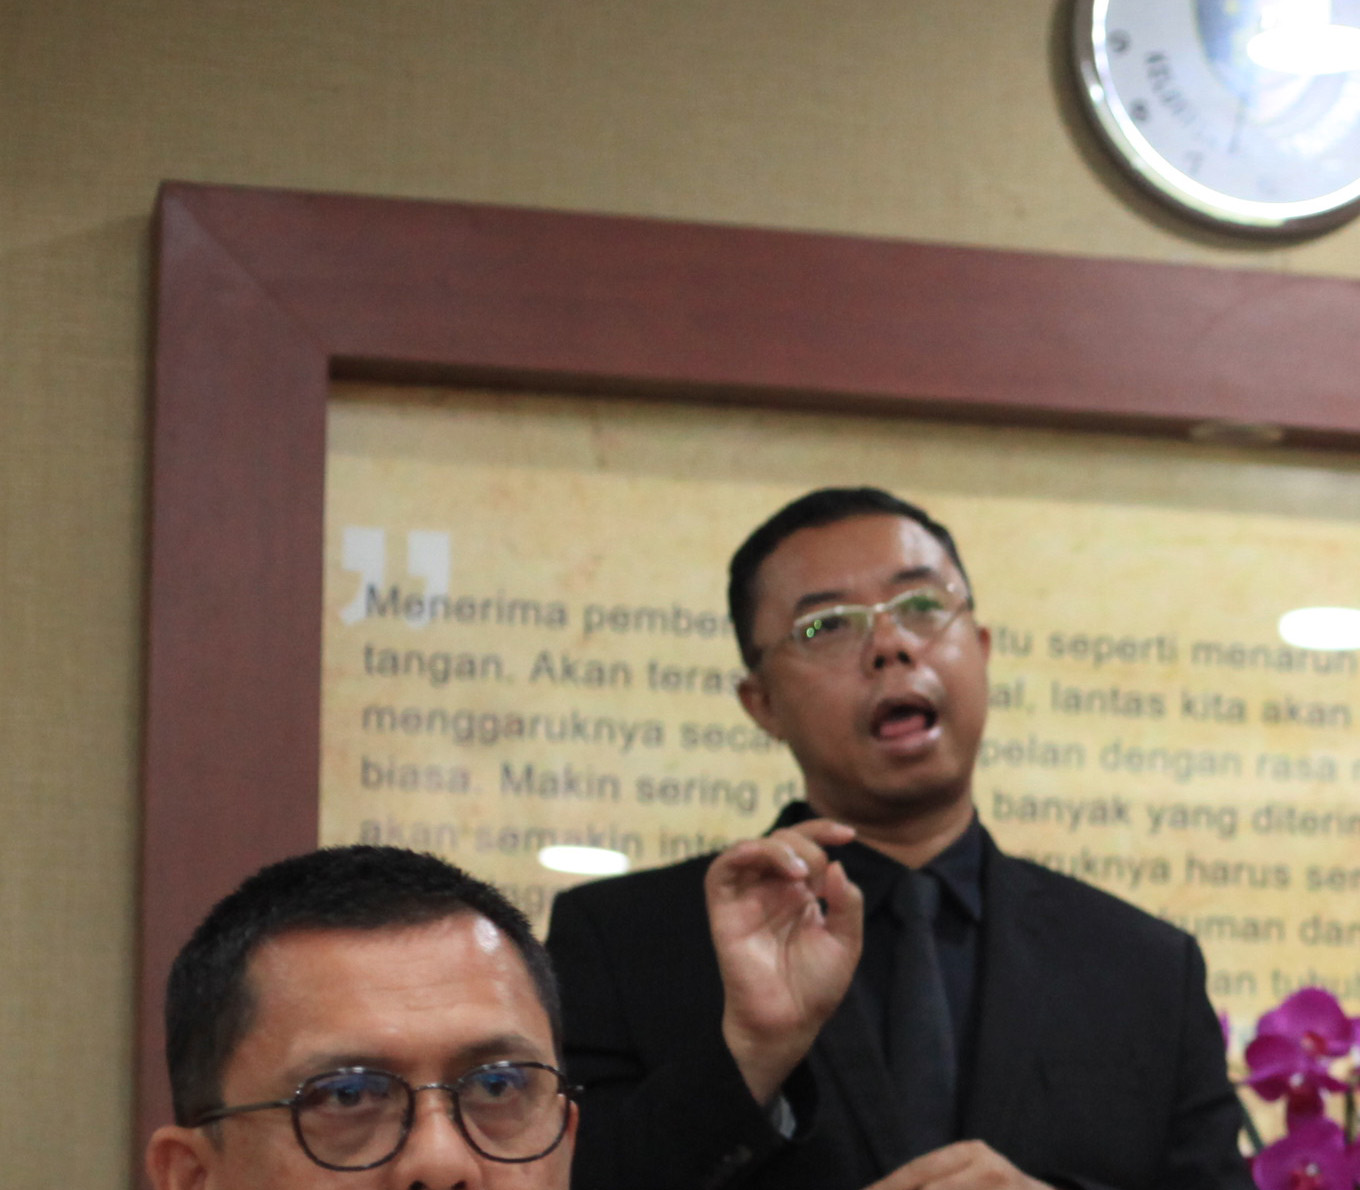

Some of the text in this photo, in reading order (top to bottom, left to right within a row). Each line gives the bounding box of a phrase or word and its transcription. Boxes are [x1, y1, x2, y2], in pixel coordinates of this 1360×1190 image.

[365, 583, 568, 631] Menerima
[1048, 632, 1179, 669] seperti
[530, 650, 634, 692] Akan
[1050, 680, 1168, 718] lantas
[1180, 688, 1247, 725] kita
[1261, 694, 1354, 731] akan
[362, 705, 664, 756] menggaruknya
[1100, 738, 1243, 784] dengan
[1255, 753, 1338, 783] rasa
[501, 762, 622, 802] Makin
[636, 772, 760, 818] sering
[992, 789, 1131, 833] banyak
[1146, 802, 1239, 841] yang
[360, 817, 460, 856] akan
[1184, 852, 1290, 890] harus
